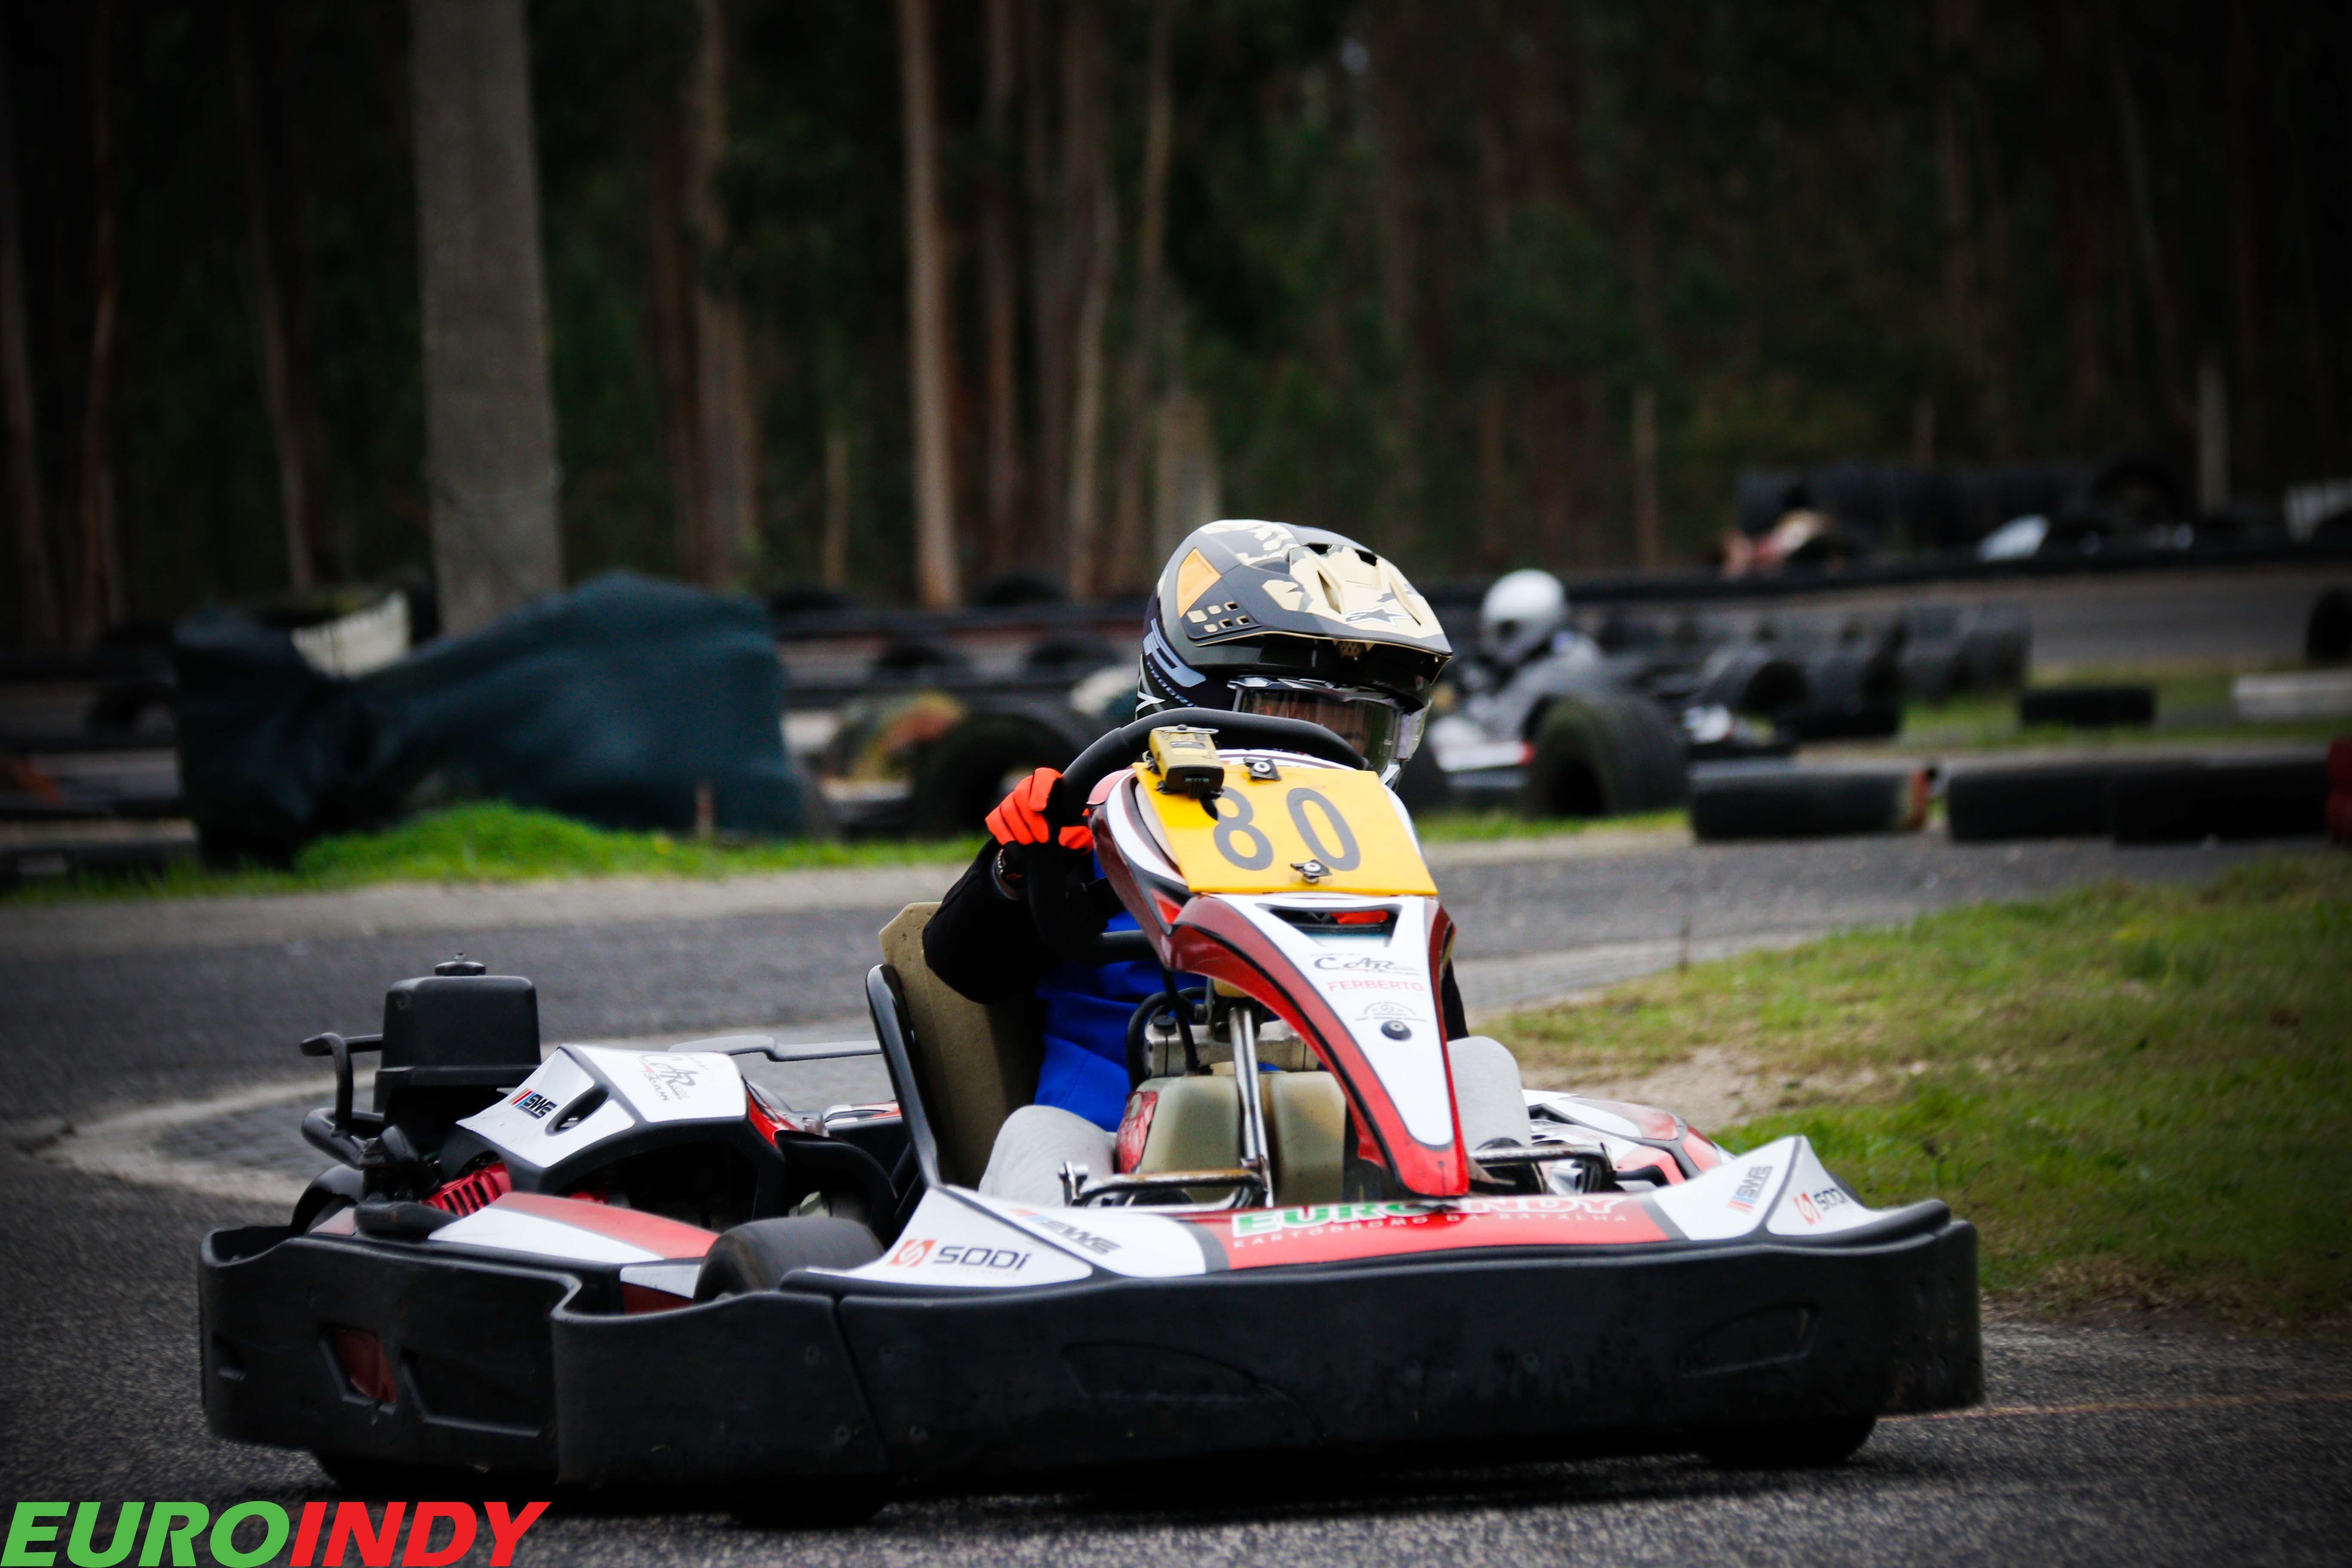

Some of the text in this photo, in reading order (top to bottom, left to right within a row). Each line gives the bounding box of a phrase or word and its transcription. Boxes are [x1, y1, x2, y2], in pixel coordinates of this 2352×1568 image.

[1213, 787, 1360, 871] 80
[1327, 980, 1424, 992] FERBERTO
[523, 1093, 557, 1117] SWS
[1231, 1197, 1628, 1238] EURONDY
[1233, 1212, 1627, 1248] KARTODROMO DA BATALHA
